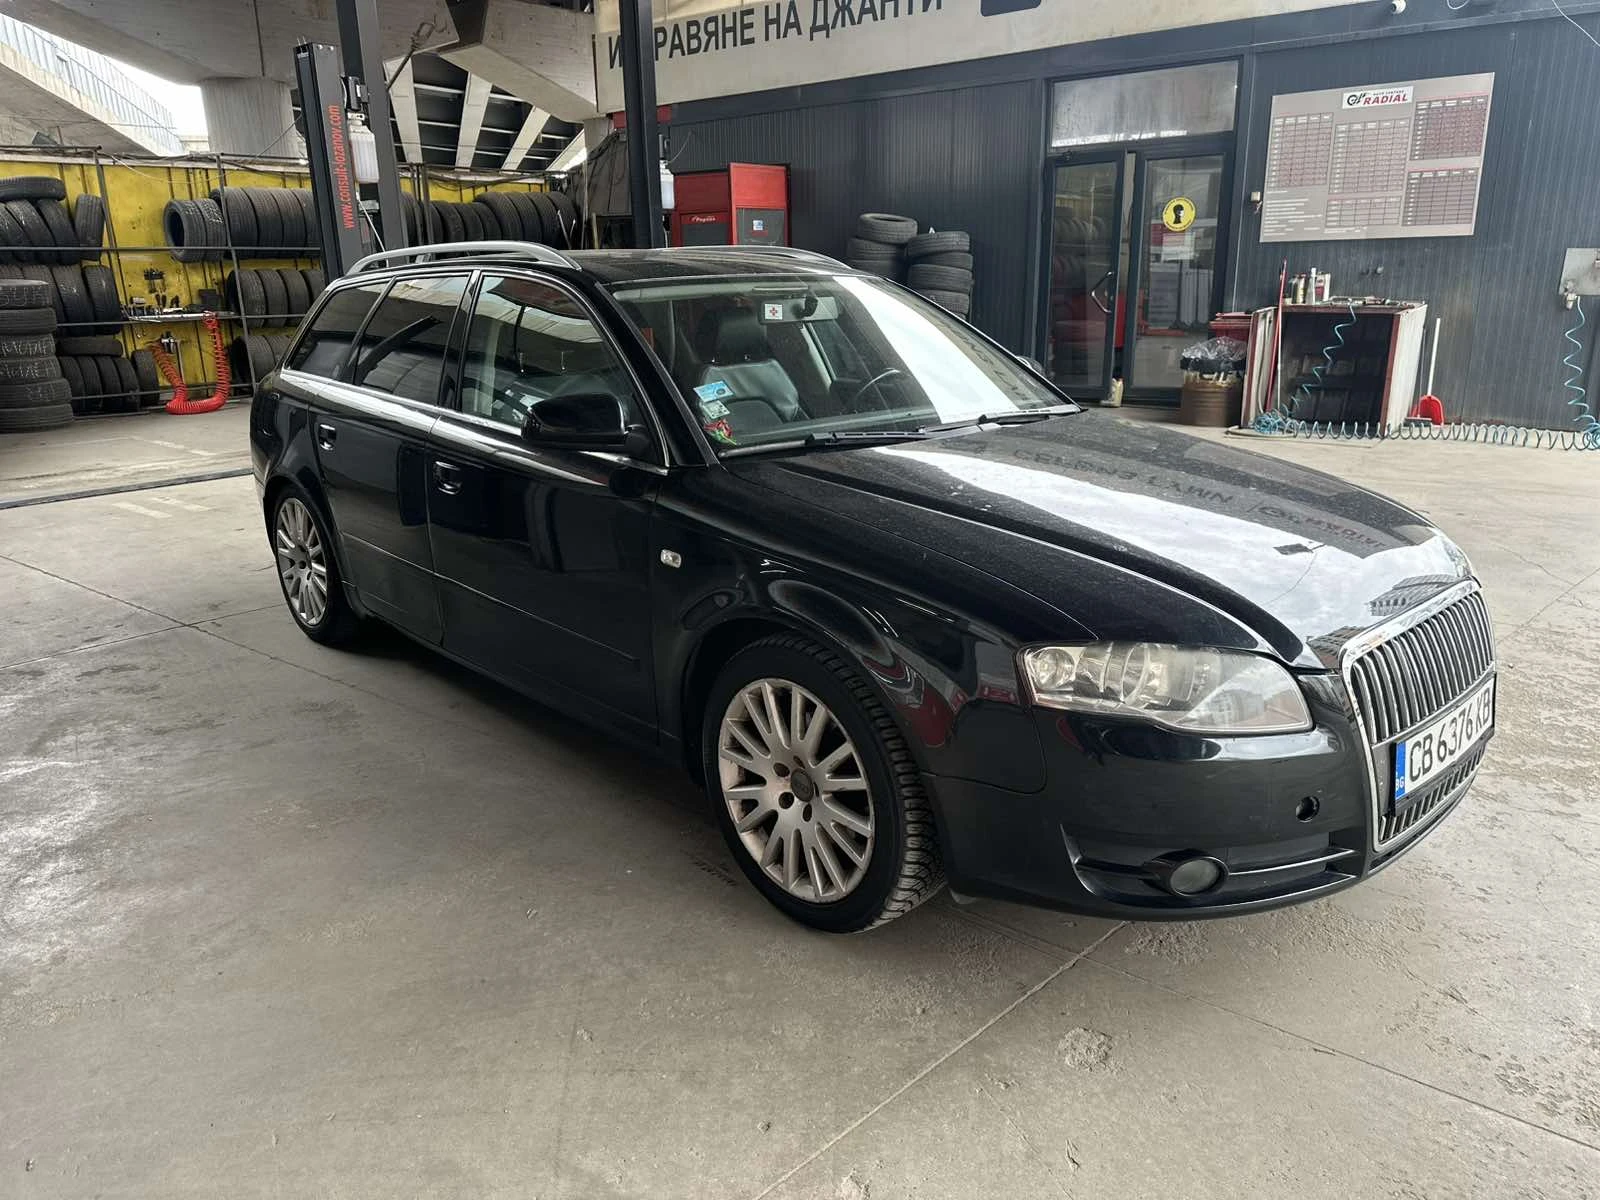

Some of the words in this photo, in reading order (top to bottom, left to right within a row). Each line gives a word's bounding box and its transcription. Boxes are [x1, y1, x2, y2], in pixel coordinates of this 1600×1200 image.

[608, 8, 755, 69] ИРАВЯНЕ
[764, 1, 802, 41] НА
[1363, 94, 1408, 106] RADIAL
[328, 105, 356, 229] www.consult-lozanov.com
[1409, 733, 1433, 782] CB
[1437, 703, 1473, 763] 6376
[1396, 776, 1405, 791] BG
